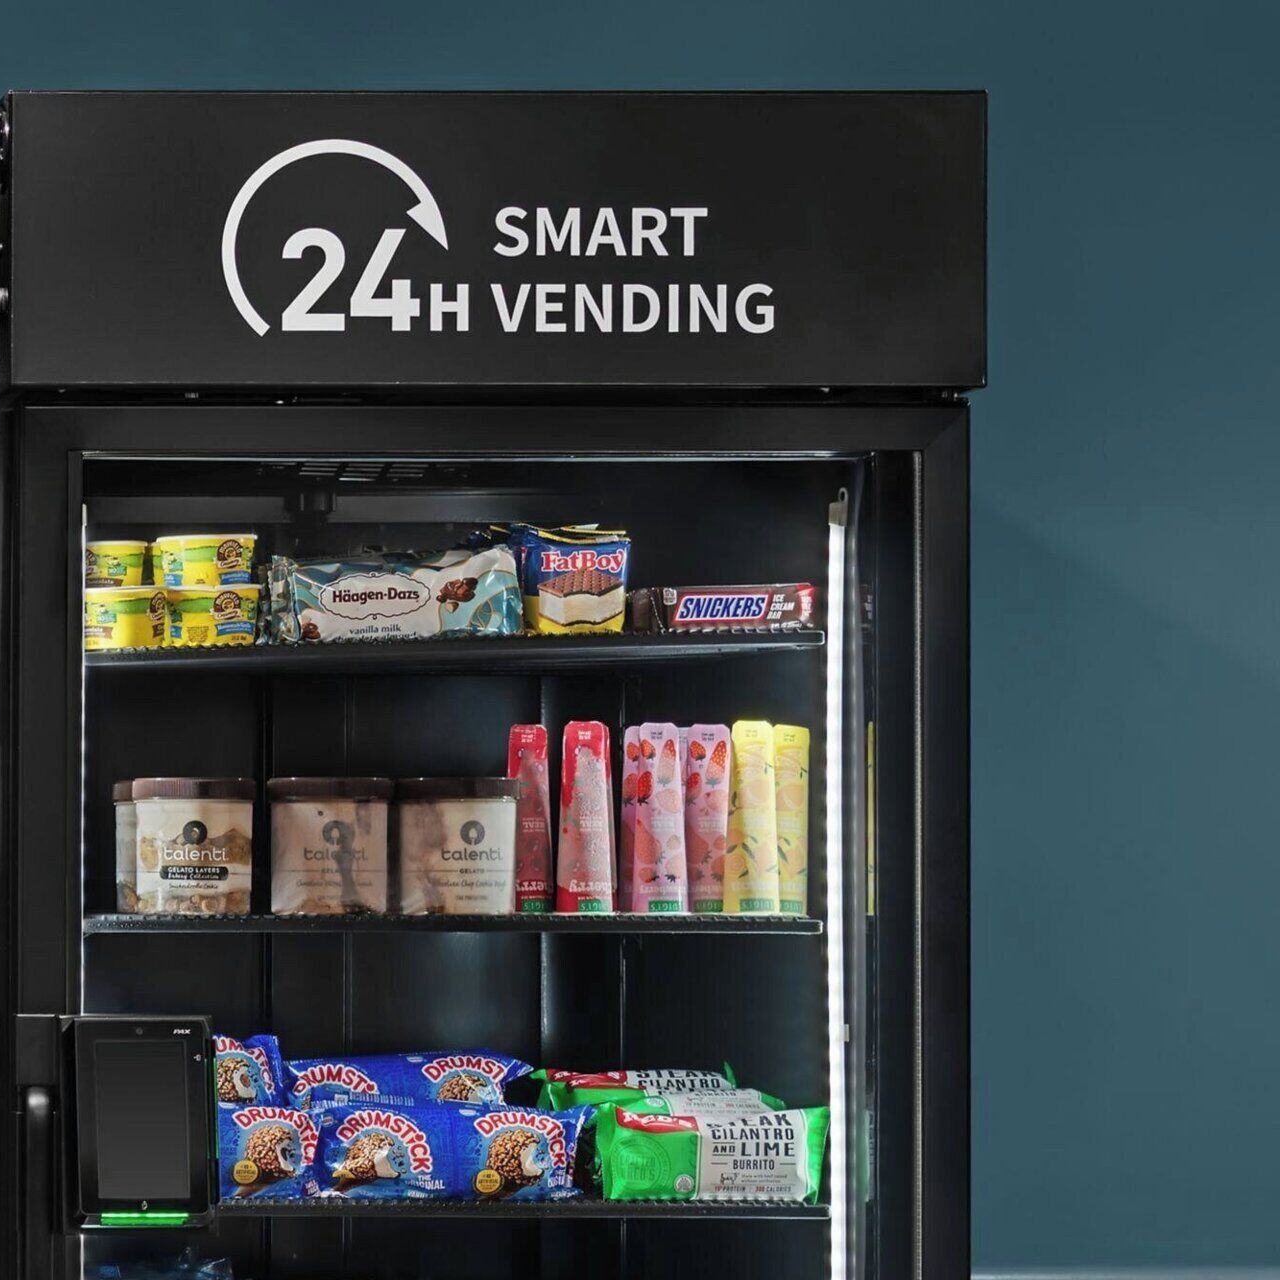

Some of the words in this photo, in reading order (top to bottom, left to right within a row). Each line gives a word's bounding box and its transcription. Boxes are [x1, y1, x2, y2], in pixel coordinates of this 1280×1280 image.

[493, 207, 708, 257] SMART
[281, 227, 470, 332] 24H
[491, 283, 776, 333] VENDING
[541, 549, 625, 574] FatBoy
[332, 587, 420, 605] Häagen-Dazs
[679, 597, 766, 619] SNICKERS
[349, 625, 380, 636] vanilla
[382, 624, 401, 633] milk
[163, 846, 228, 862] talenti
[441, 846, 503, 862] talenti
[234, 1107, 320, 1166] DRUMSTICK
[337, 1110, 432, 1171] DRUMSTICK
[474, 1110, 566, 1168] DRUMSTICK
[712, 1128, 794, 1141] CILANTRO
[742, 1142, 795, 1157] LIME
[733, 1159, 775, 1170] BURRITO
